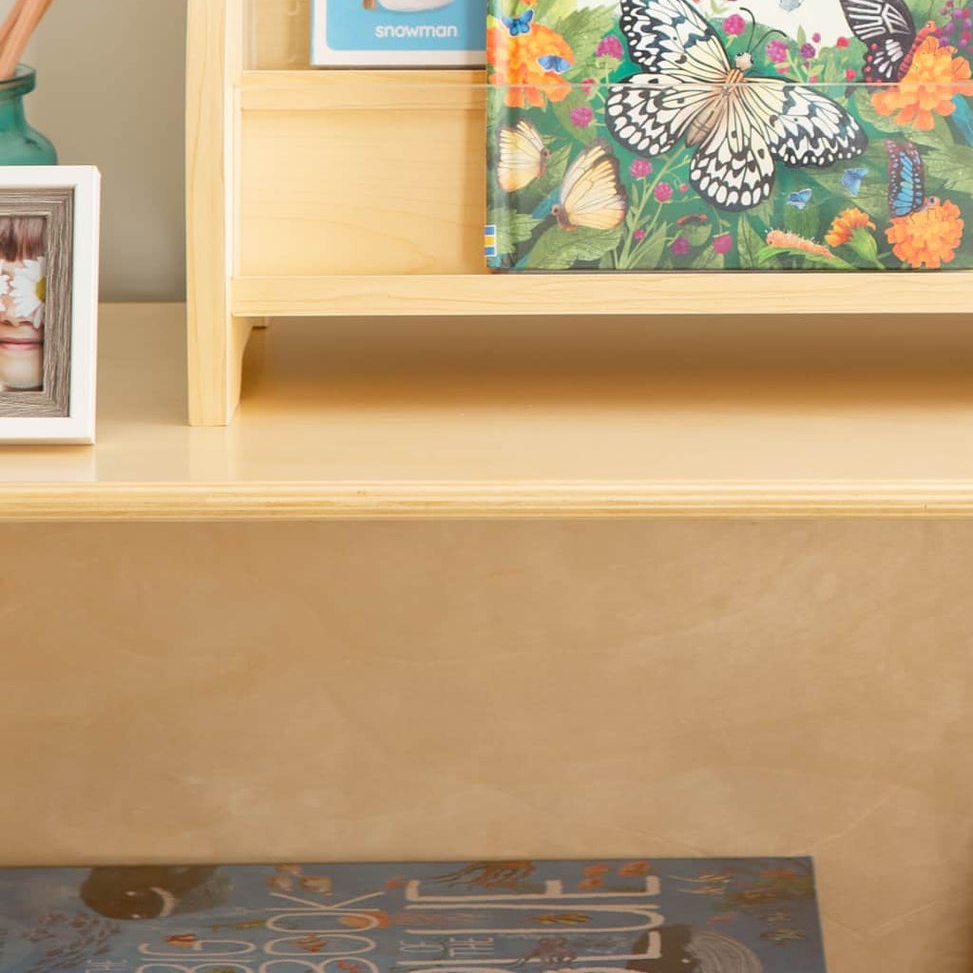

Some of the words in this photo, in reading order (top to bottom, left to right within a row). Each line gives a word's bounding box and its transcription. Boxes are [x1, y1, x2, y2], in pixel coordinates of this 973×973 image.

[375, 24, 457, 38] snowman
[259, 891, 386, 973] BOOK
[396, 875, 665, 973] LUE
[450, 937, 495, 958] THE
